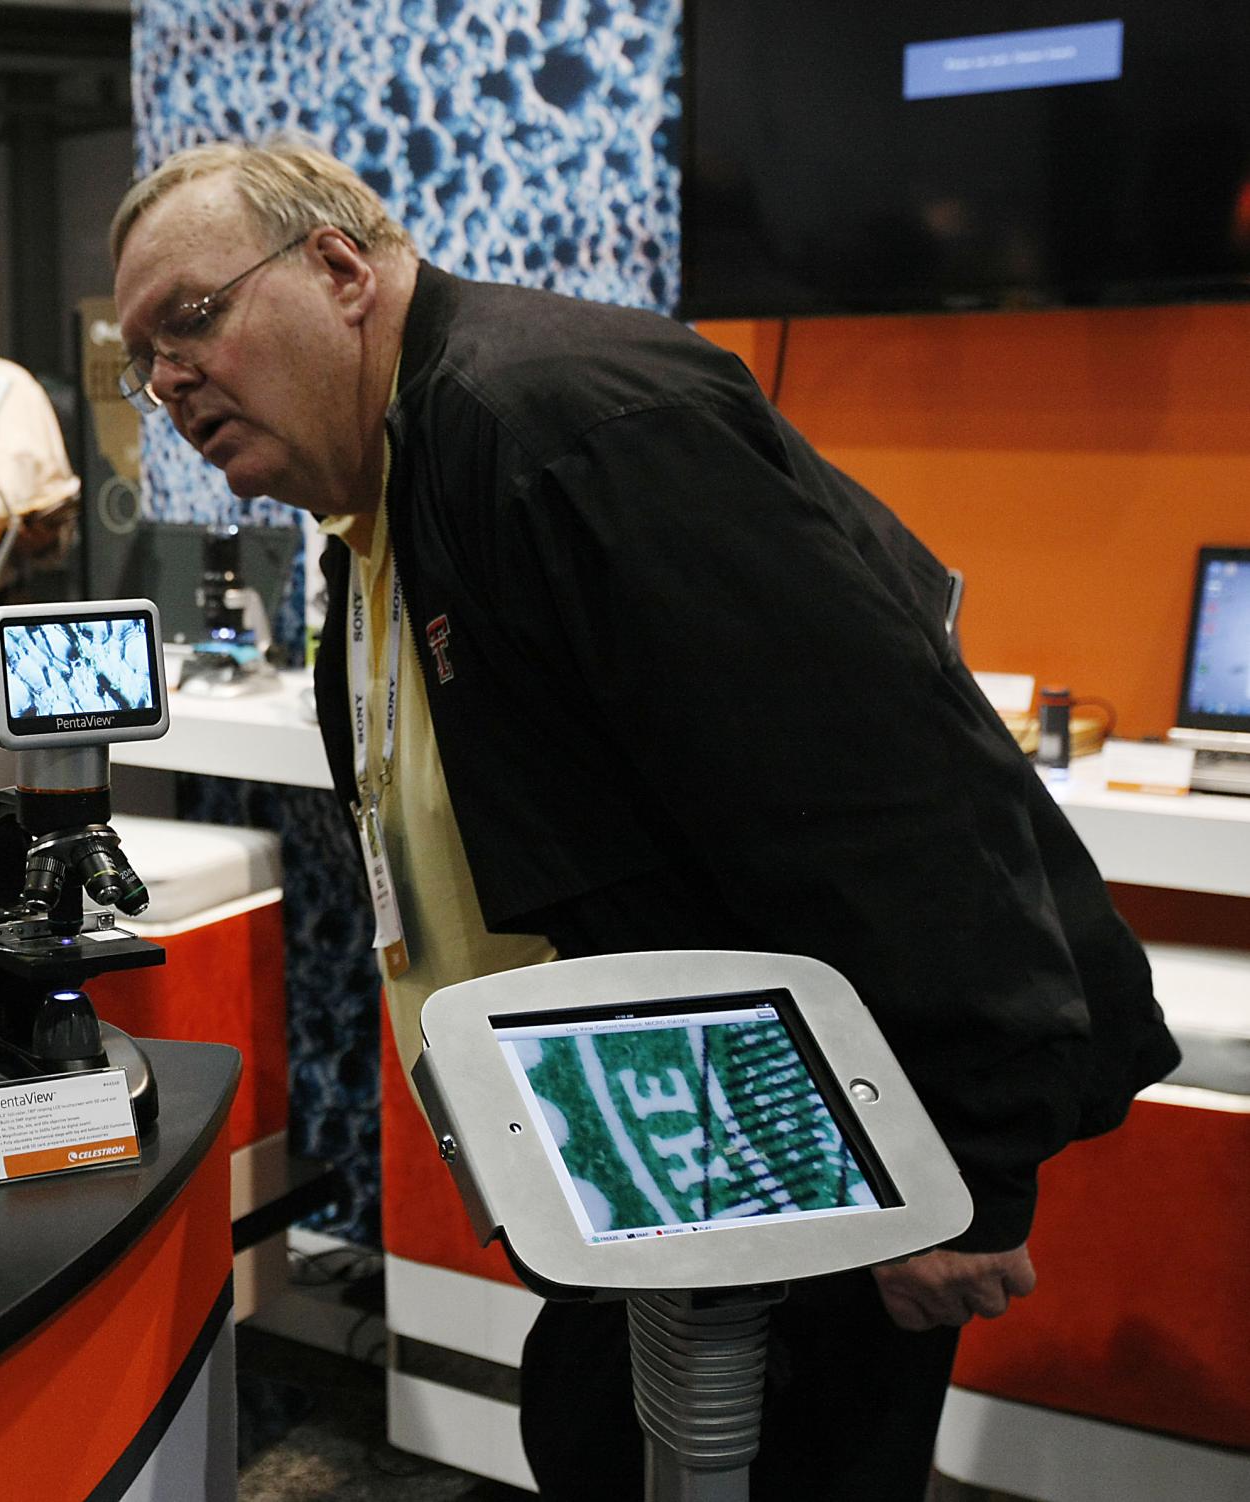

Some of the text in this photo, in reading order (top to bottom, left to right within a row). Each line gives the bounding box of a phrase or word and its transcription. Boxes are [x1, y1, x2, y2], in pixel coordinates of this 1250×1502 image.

[353, 592, 363, 642] SONY
[56, 716, 112, 729] PentaView
[356, 694, 364, 743] SONY
[388, 679, 396, 730] SONY
[79, 1145, 125, 1159] CELESTRON
